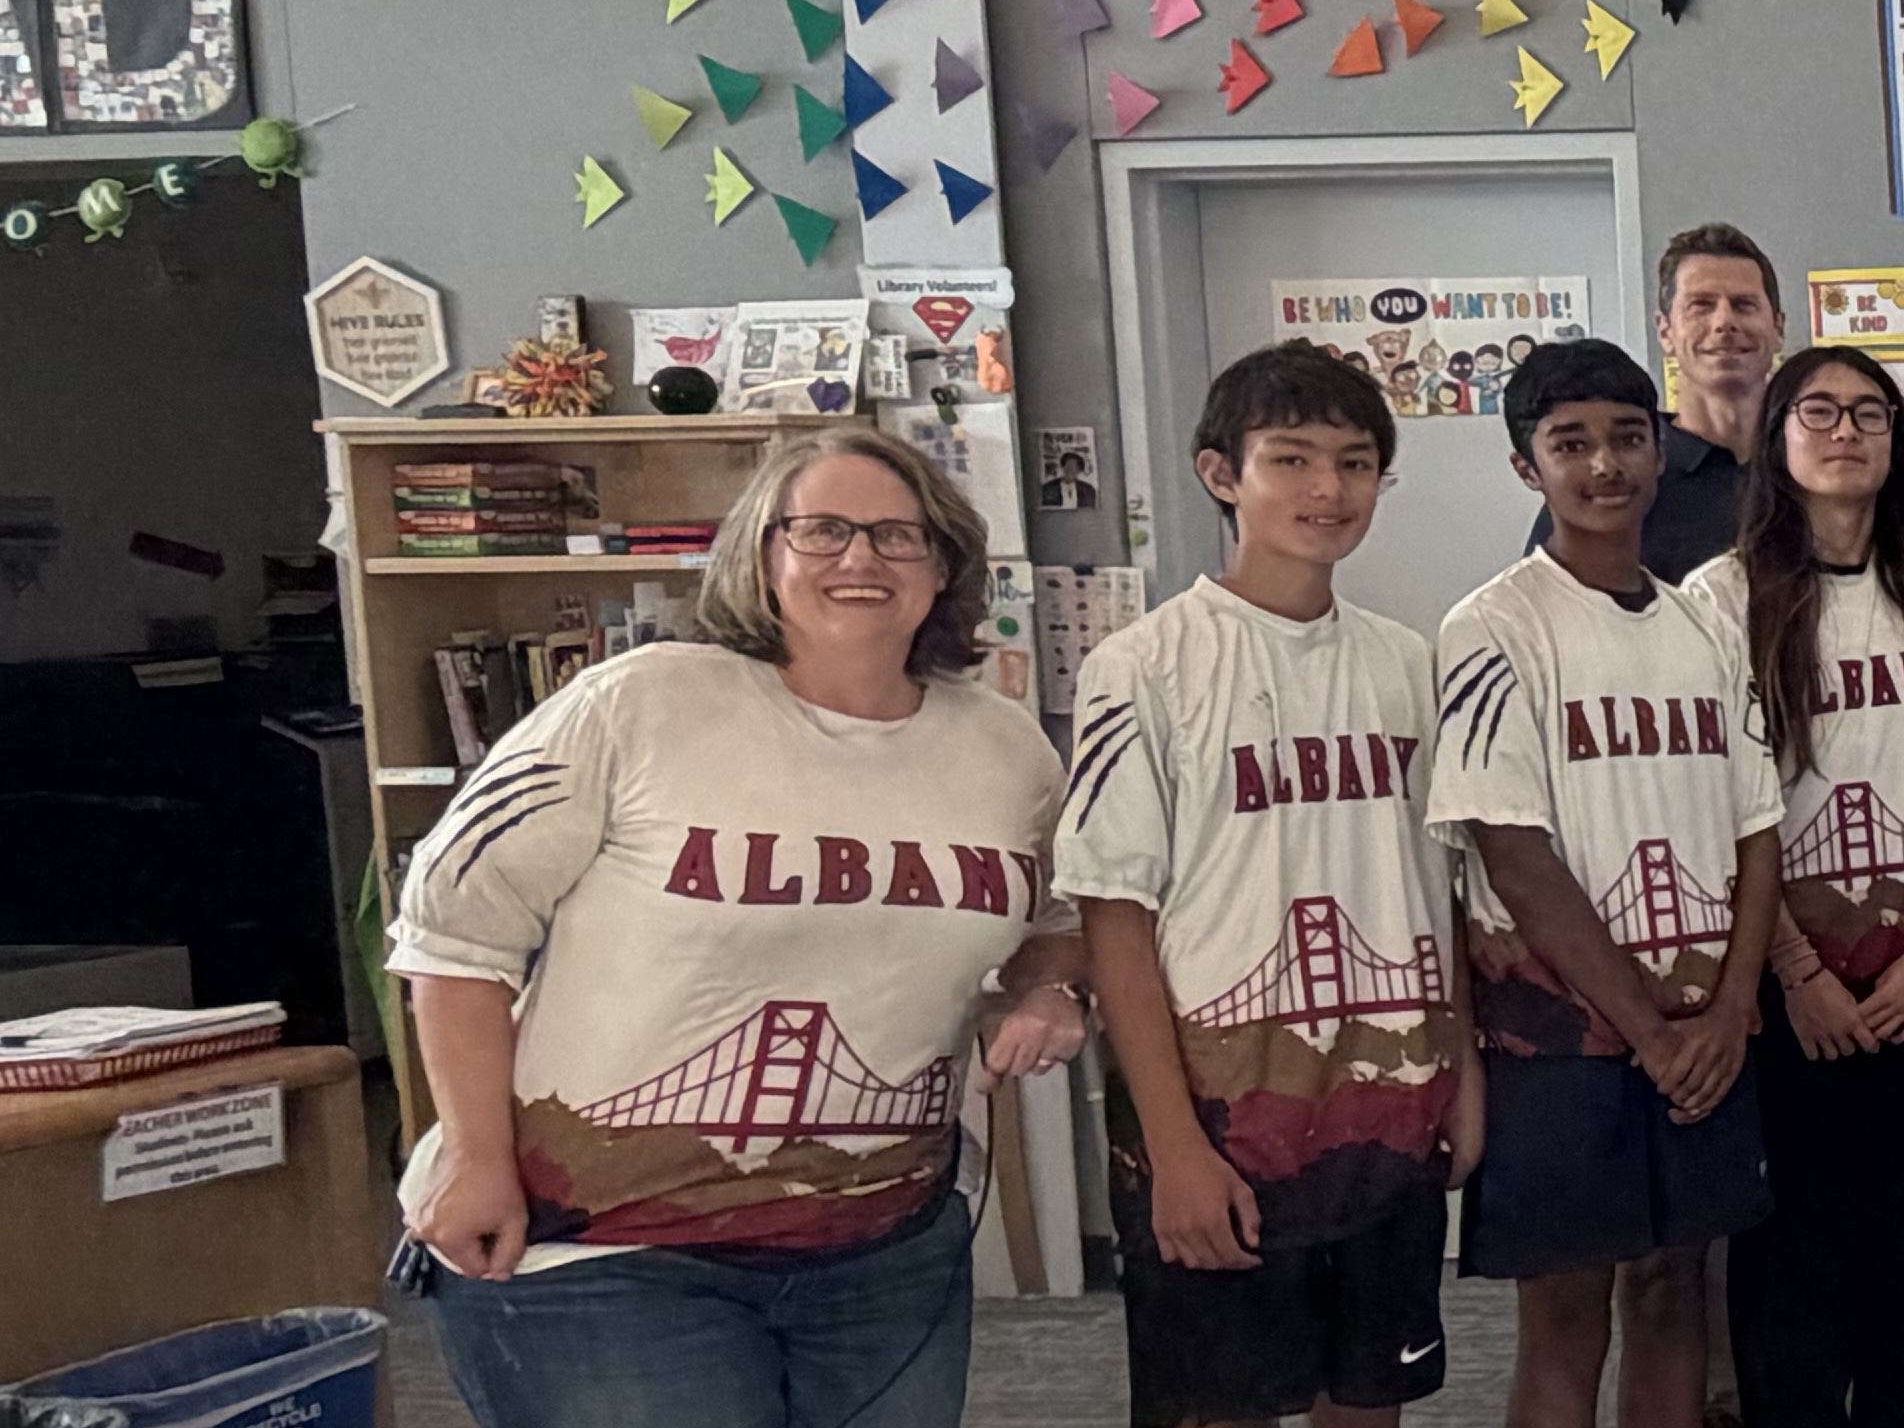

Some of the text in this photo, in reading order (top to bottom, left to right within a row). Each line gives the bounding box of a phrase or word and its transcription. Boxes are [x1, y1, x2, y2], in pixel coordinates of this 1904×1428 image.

[876, 279, 924, 296] Library
[1282, 291, 1573, 324] BE WHO YOU WANT TO BE!
[1856, 294, 1878, 313] BE
[1848, 315, 1888, 334] KIND
[1564, 695, 1731, 763] ALBAN
[269, 1395, 296, 1417] WE
